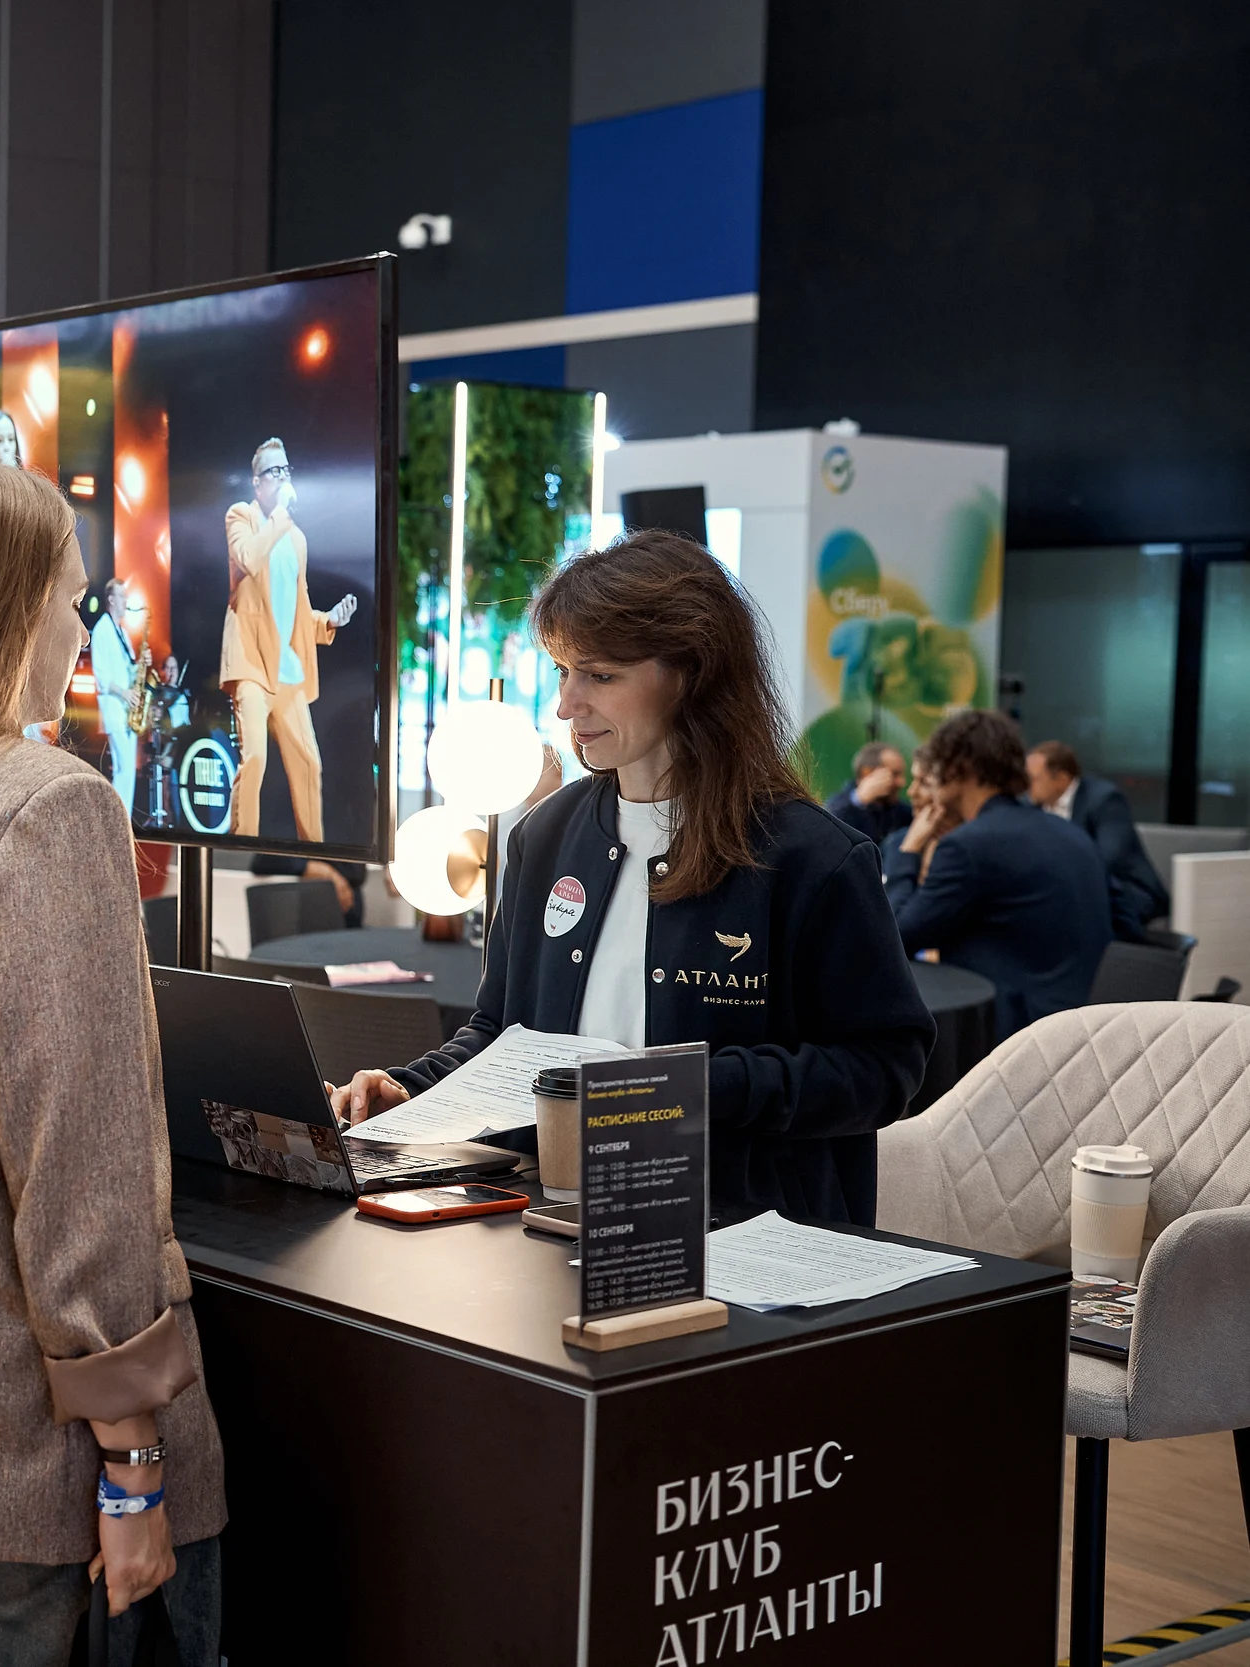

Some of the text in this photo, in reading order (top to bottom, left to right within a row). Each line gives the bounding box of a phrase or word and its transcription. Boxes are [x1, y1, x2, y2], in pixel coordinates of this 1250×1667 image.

[154, 978, 171, 987] acer
[674, 969, 768, 989] АТЛАНТ
[587, 1111, 647, 1128] РАСПИСАНИЕ
[588, 1145, 594, 1155] 9
[588, 1229, 598, 1239] 10
[656, 1440, 855, 1536] БИЗНЕС-
[654, 1524, 781, 1607] КЛУБ
[655, 1561, 883, 1667] АТЛАНТЫ
